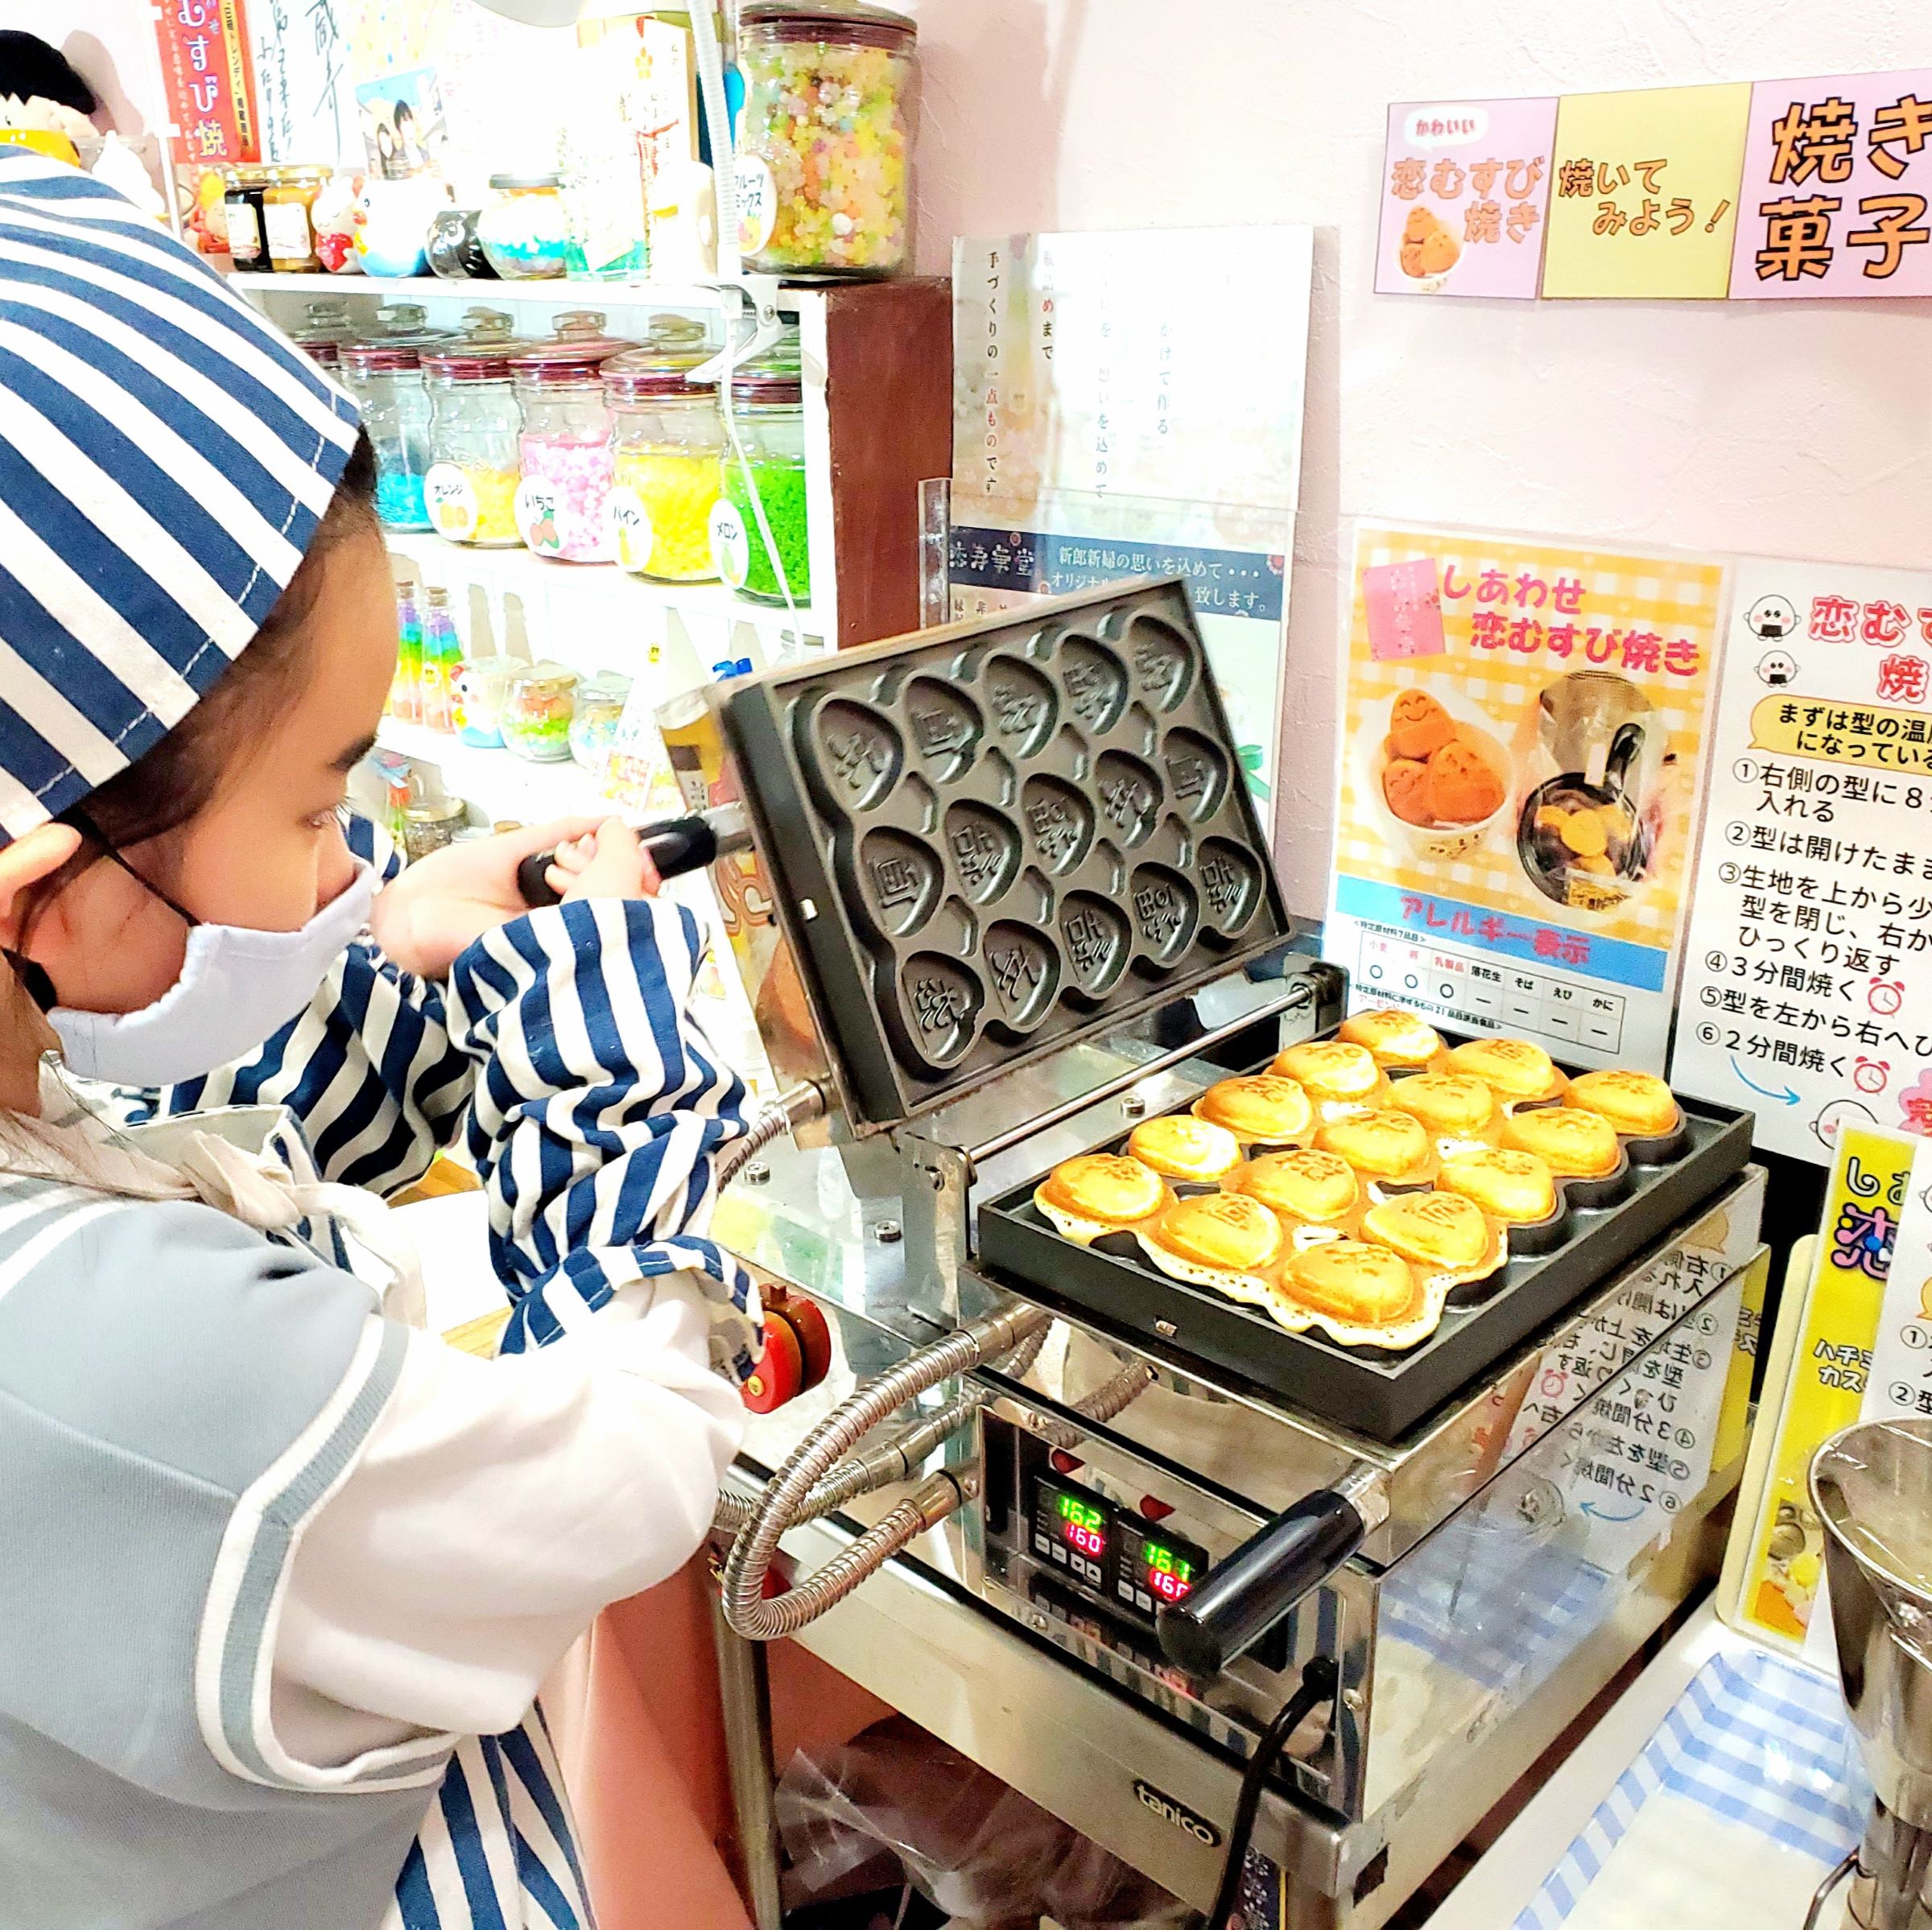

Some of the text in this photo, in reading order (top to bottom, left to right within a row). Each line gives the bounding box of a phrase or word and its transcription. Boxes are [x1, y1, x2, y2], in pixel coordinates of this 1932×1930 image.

[1416, 119, 1475, 136] かわいい
[1768, 95, 1932, 186] 焼き
[1391, 155, 1546, 200] 恋むすび
[1558, 159, 1668, 199] 焼いて
[1464, 200, 1541, 244] 焼き
[1755, 193, 1930, 281] 菓子
[985, 251, 999, 493] 手づくりの一点ものです
[434, 485, 463, 496] オレンジ
[716, 522, 738, 540] メロン
[1443, 565, 1587, 615] しあわせ
[1471, 611, 1700, 676] 恋むすび焼き
[1780, 703, 1932, 744] まずは型の温
[1732, 758, 1932, 811] ①右側の型に8
[1757, 790, 1835, 823] 入れる
[1401, 897, 1591, 965] アレルギー表示
[1739, 926, 1900, 975] ひっくり返す
[1472, 966, 1502, 983] 落花生
[1514, 977, 1534, 991] そば
[1554, 987, 1572, 1000] えび
[1593, 998, 1614, 1012] かに
[1818, 1366, 1868, 1394] カス
[1063, 1498, 1102, 1534] 162
[1069, 1524, 1100, 1553] 160
[1147, 1544, 1191, 1582] 161
[1137, 1784, 1214, 1845] tanico
